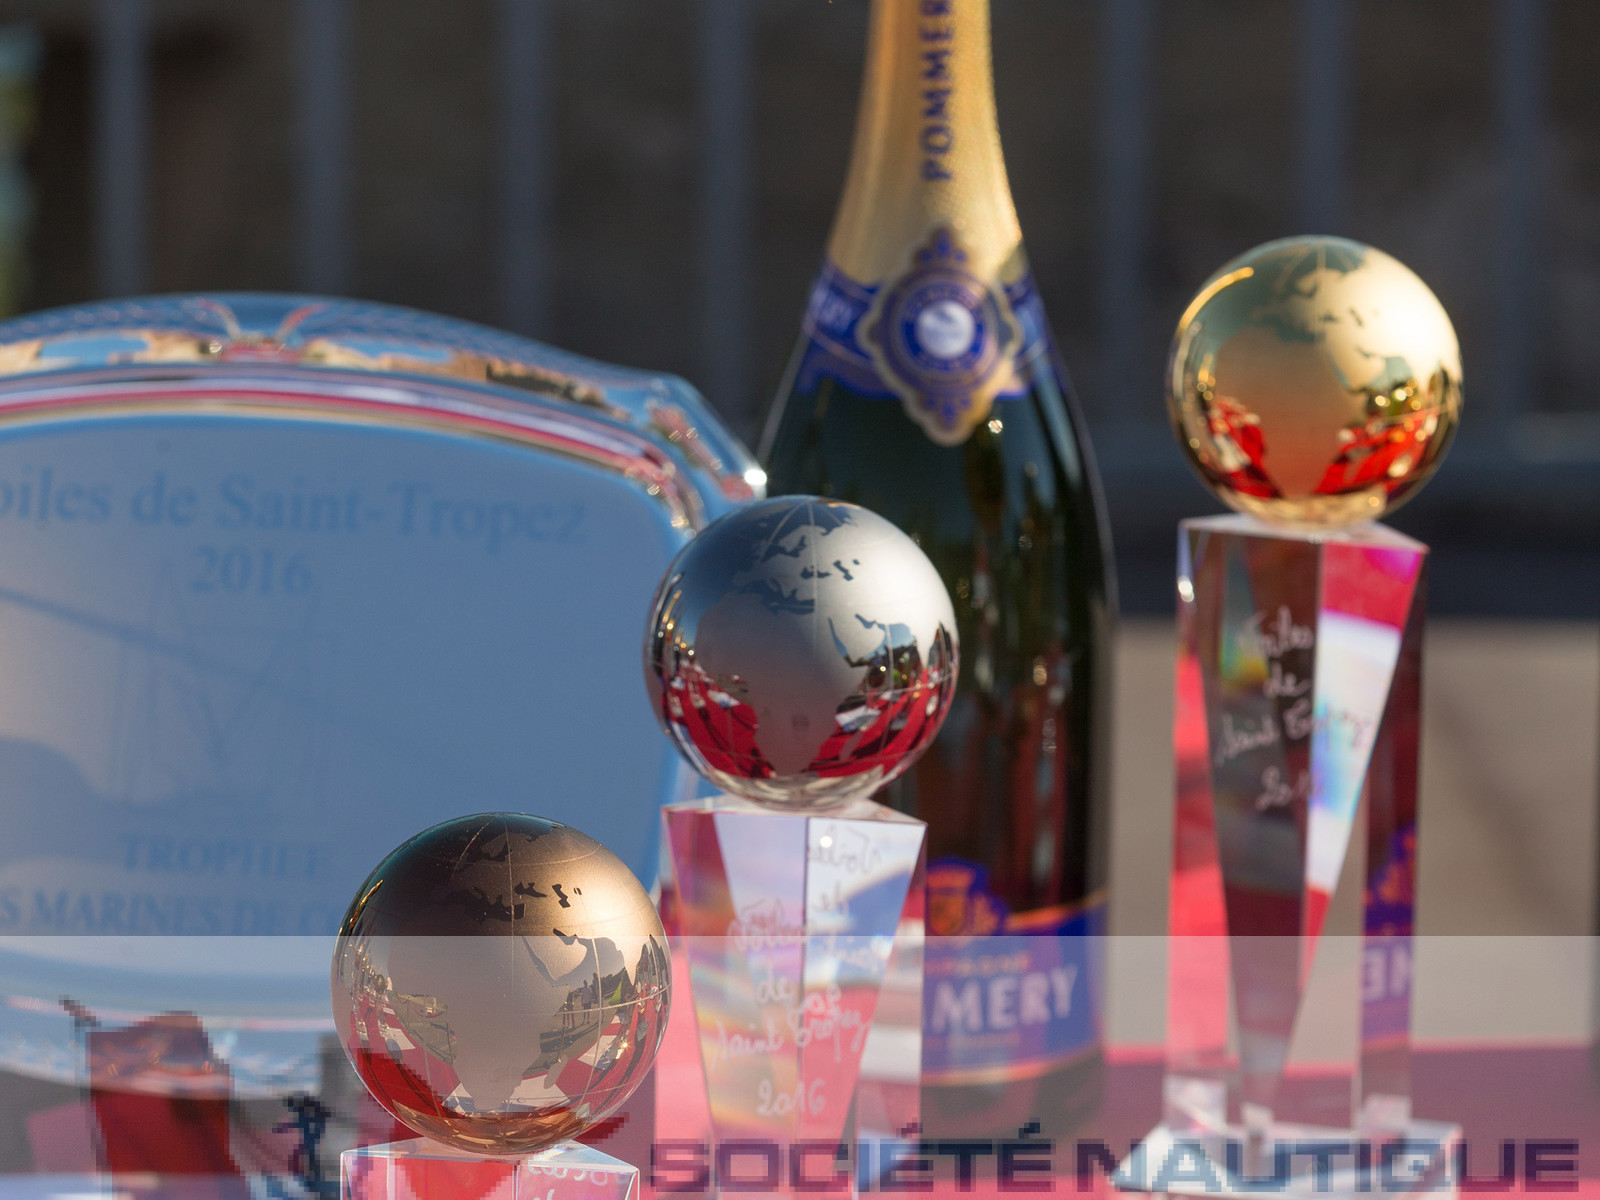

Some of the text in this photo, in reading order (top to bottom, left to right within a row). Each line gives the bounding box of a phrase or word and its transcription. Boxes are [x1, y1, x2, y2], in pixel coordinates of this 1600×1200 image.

[129, 469, 199, 526] de
[190, 543, 315, 597] 2016
[757, 1078, 827, 1118] 2016
